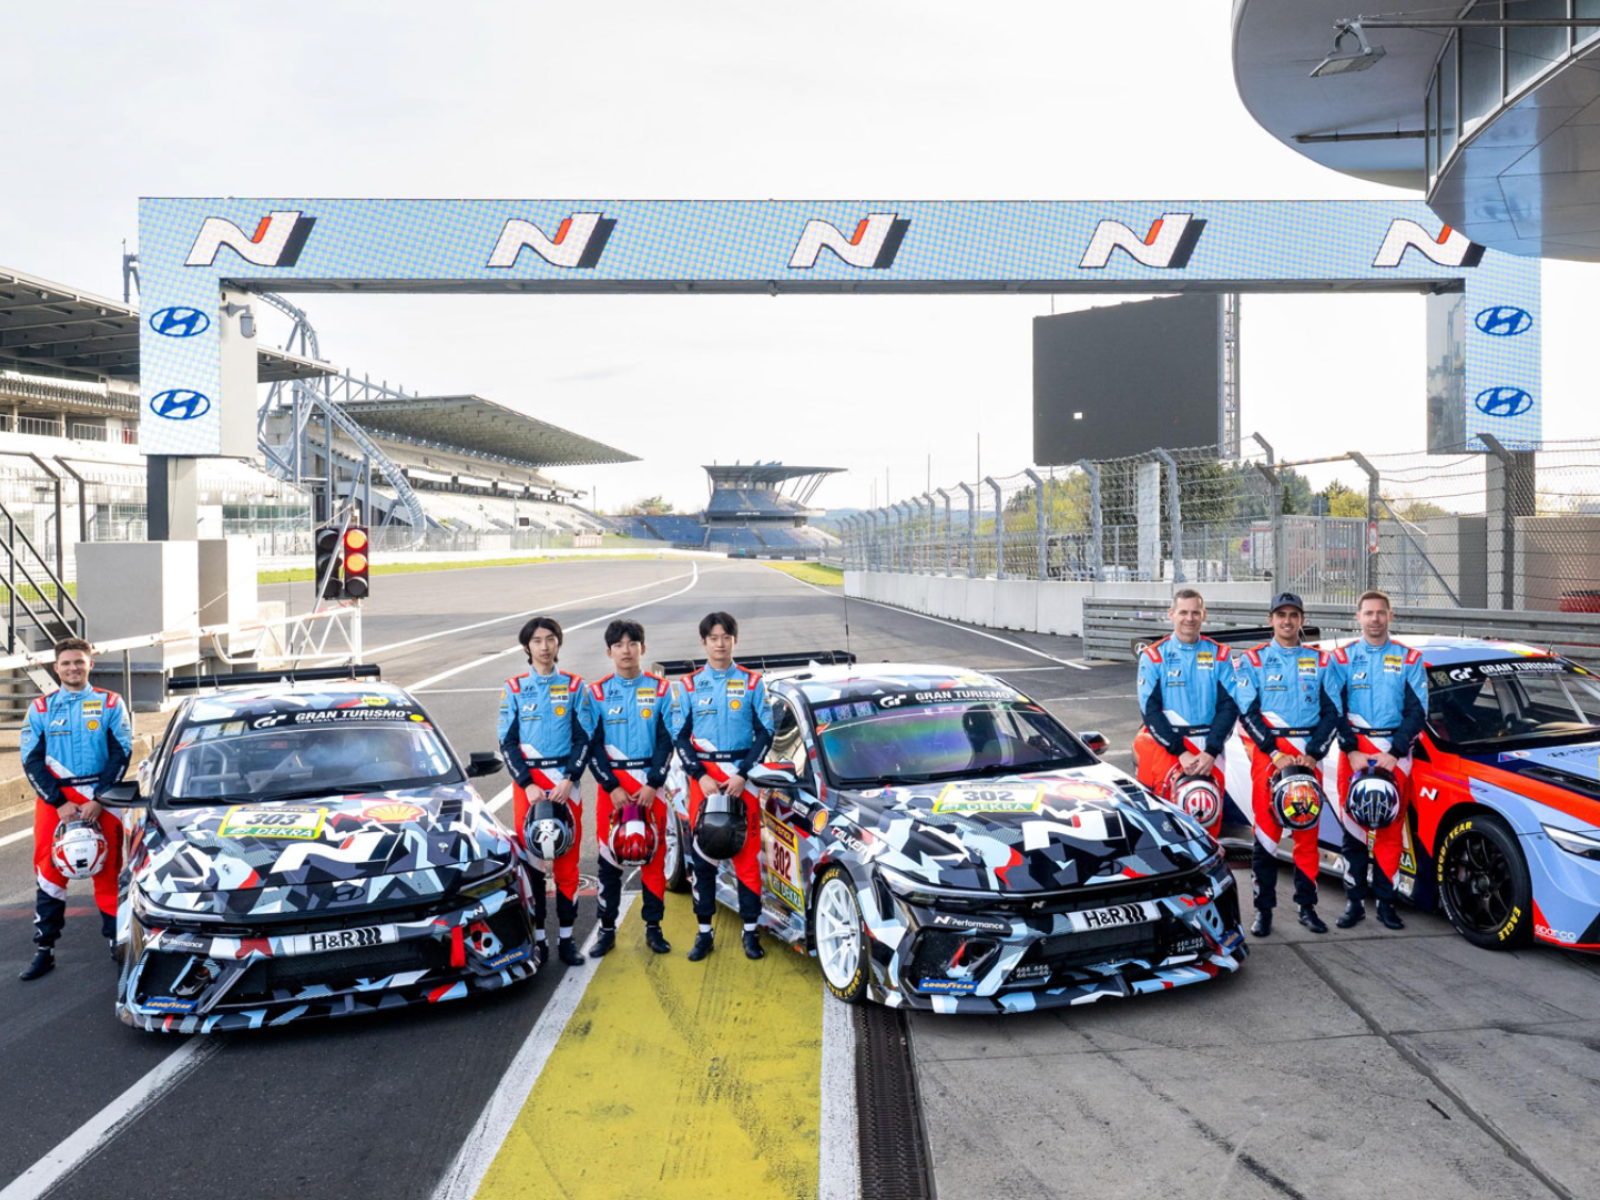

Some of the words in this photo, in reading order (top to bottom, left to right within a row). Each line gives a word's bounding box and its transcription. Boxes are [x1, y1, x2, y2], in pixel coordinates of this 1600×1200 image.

[1479, 663, 1514, 674] GRAN
[1513, 661, 1563, 671] TURISMO
[915, 690, 953, 701] GRAN
[954, 689, 1011, 699] TURISMO
[295, 710, 338, 722] GRAN
[341, 709, 407, 719] TURISMO
[963, 790, 1016, 802] 302
[966, 803, 1027, 811] DEKRA
[245, 813, 303, 827] 303
[256, 828, 313, 838] DEKRA
[831, 826, 868, 857] FALKEN
[772, 841, 793, 882] 302
[951, 918, 1005, 931] Performance
[1083, 908, 1124, 928] H&R
[1497, 905, 1522, 942] EAGLE
[1534, 924, 1577, 941] sparco
[160, 936, 204, 949] Performance
[310, 932, 355, 952] H&R
[923, 982, 975, 990] GOODYEAR
[146, 1001, 192, 1010] GOODYEAR
